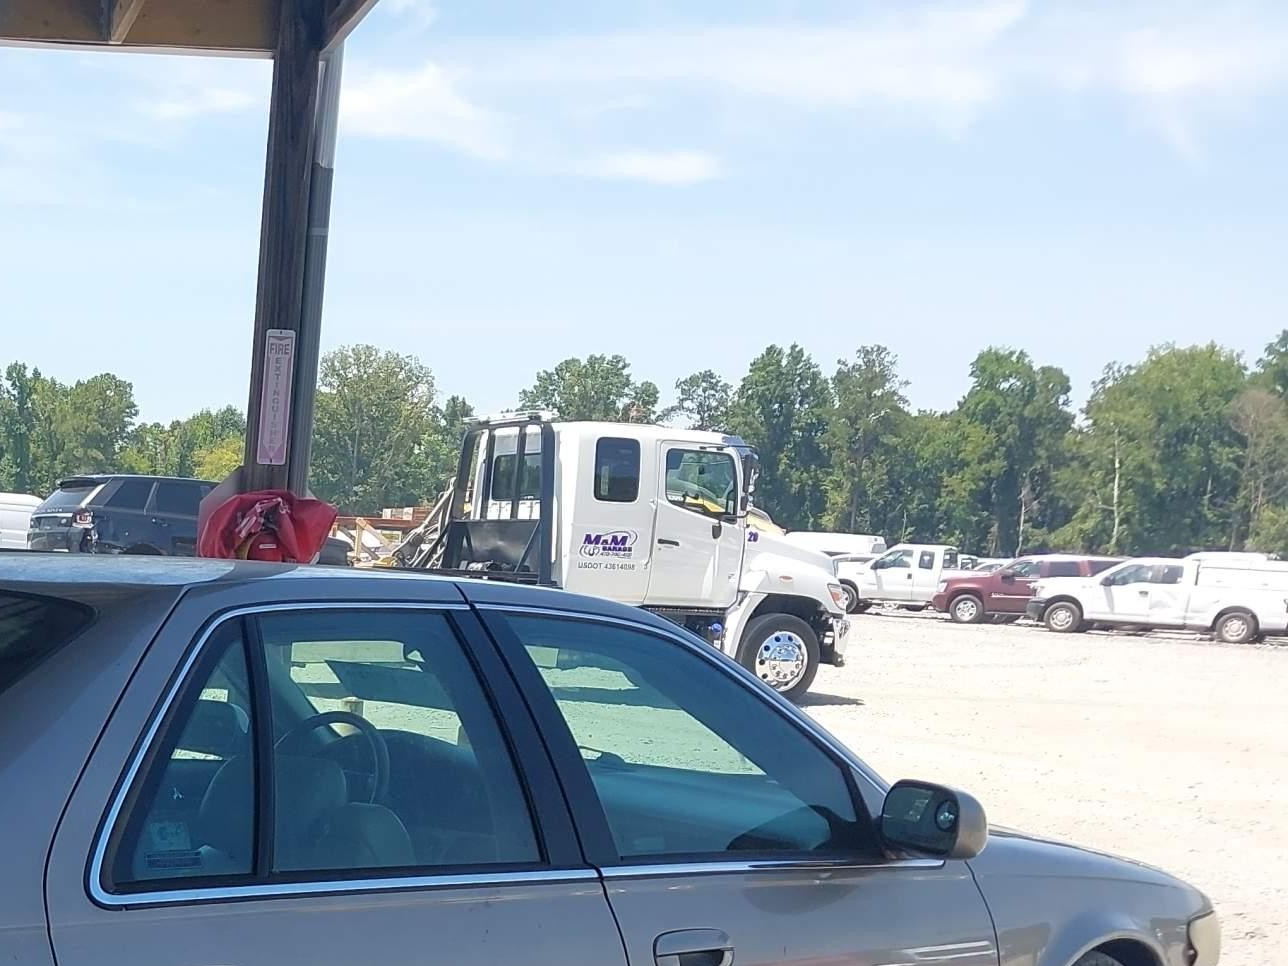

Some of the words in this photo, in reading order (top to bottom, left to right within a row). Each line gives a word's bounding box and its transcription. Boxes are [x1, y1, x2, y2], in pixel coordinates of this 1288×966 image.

[269, 343, 290, 355] FIRE
[583, 534, 628, 546] M&M
[747, 531, 759, 542] 20
